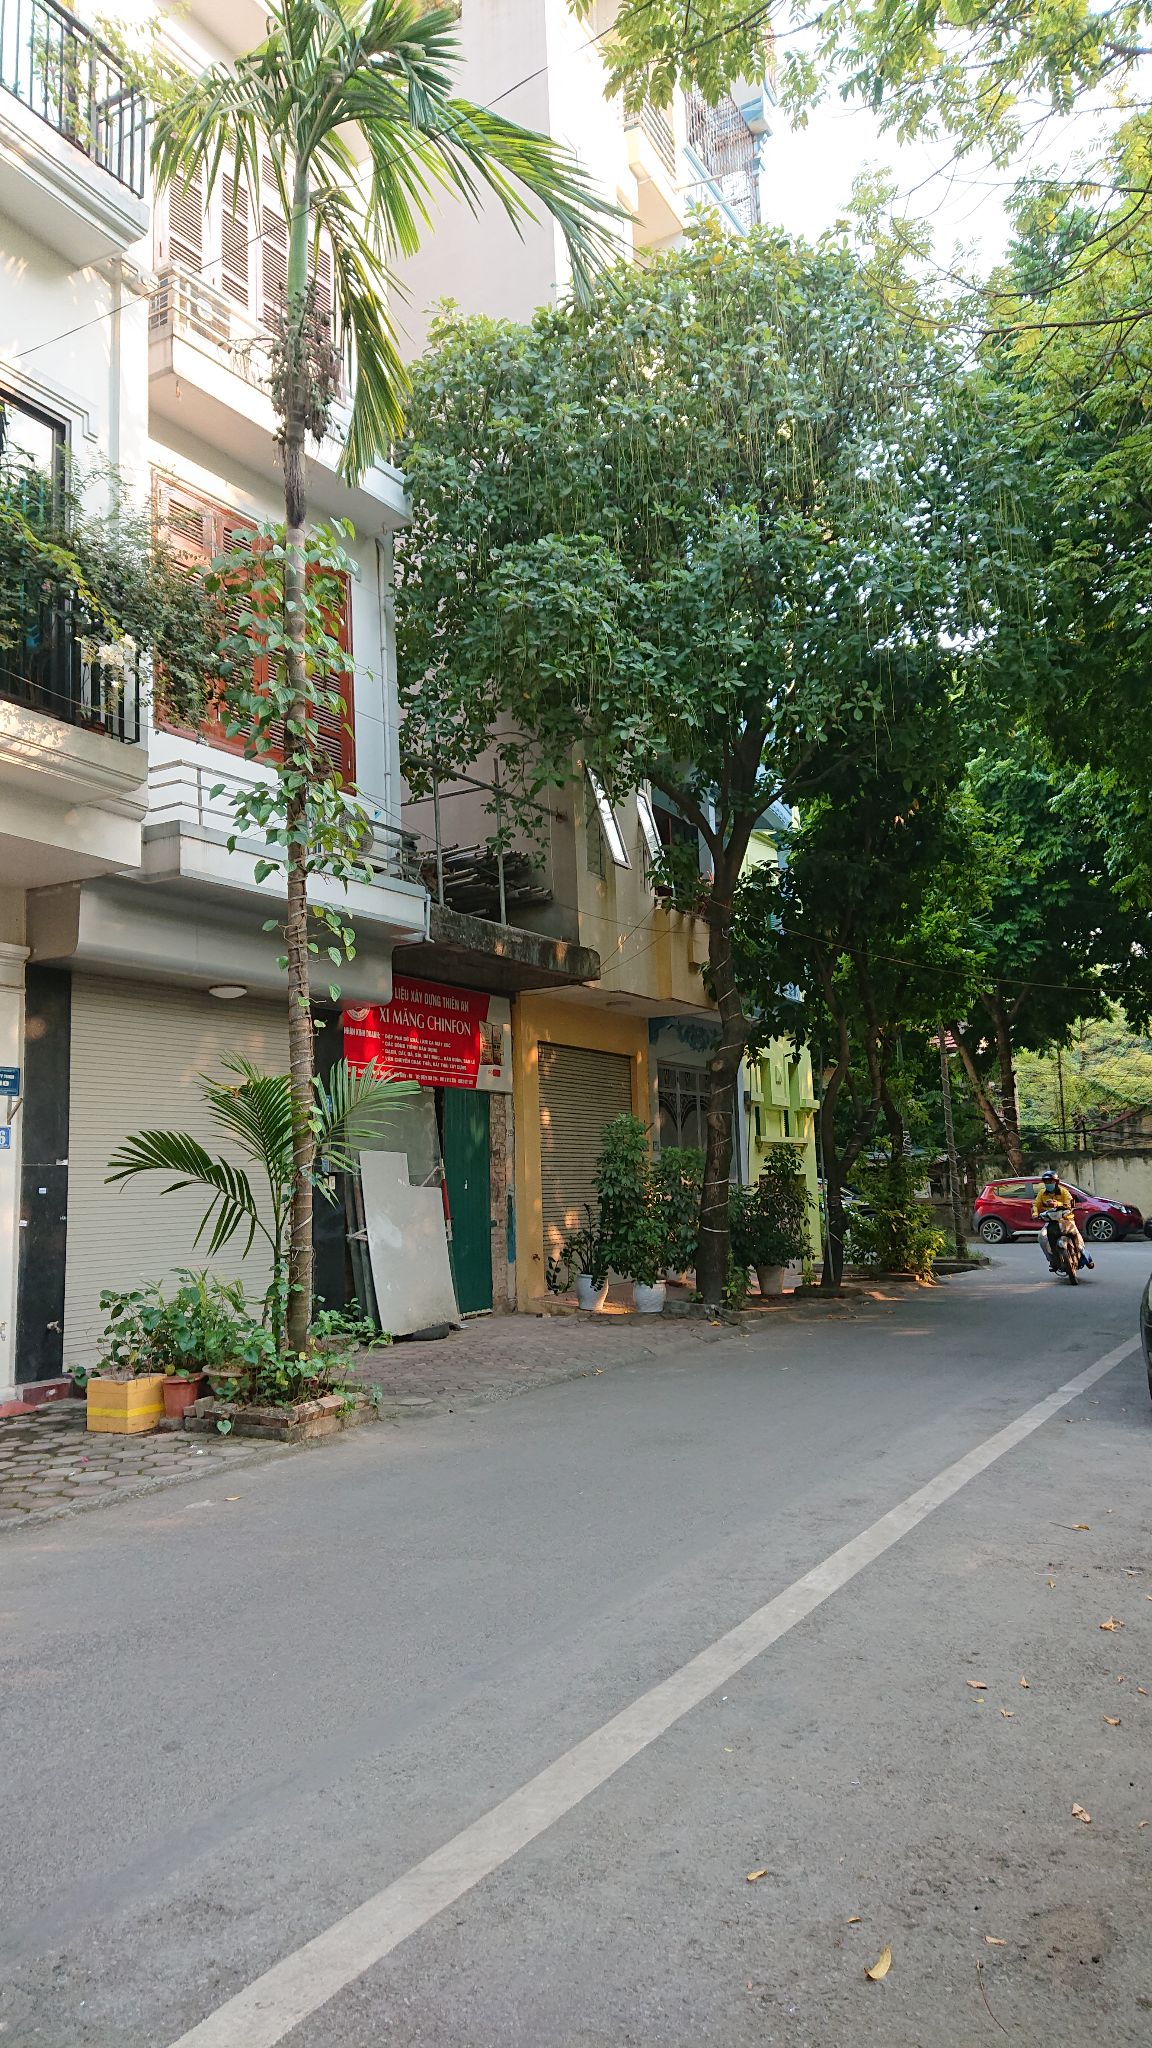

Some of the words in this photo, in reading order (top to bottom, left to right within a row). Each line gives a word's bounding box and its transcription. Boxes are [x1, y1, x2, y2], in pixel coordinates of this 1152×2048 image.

[394, 986, 409, 1003] LIỆU
[411, 989, 423, 1004] XÂY
[442, 996, 460, 1010] THIÊN
[379, 1006, 389, 1023] XI
[392, 1008, 425, 1029] MĂNG
[427, 1015, 471, 1036] CHINFON
